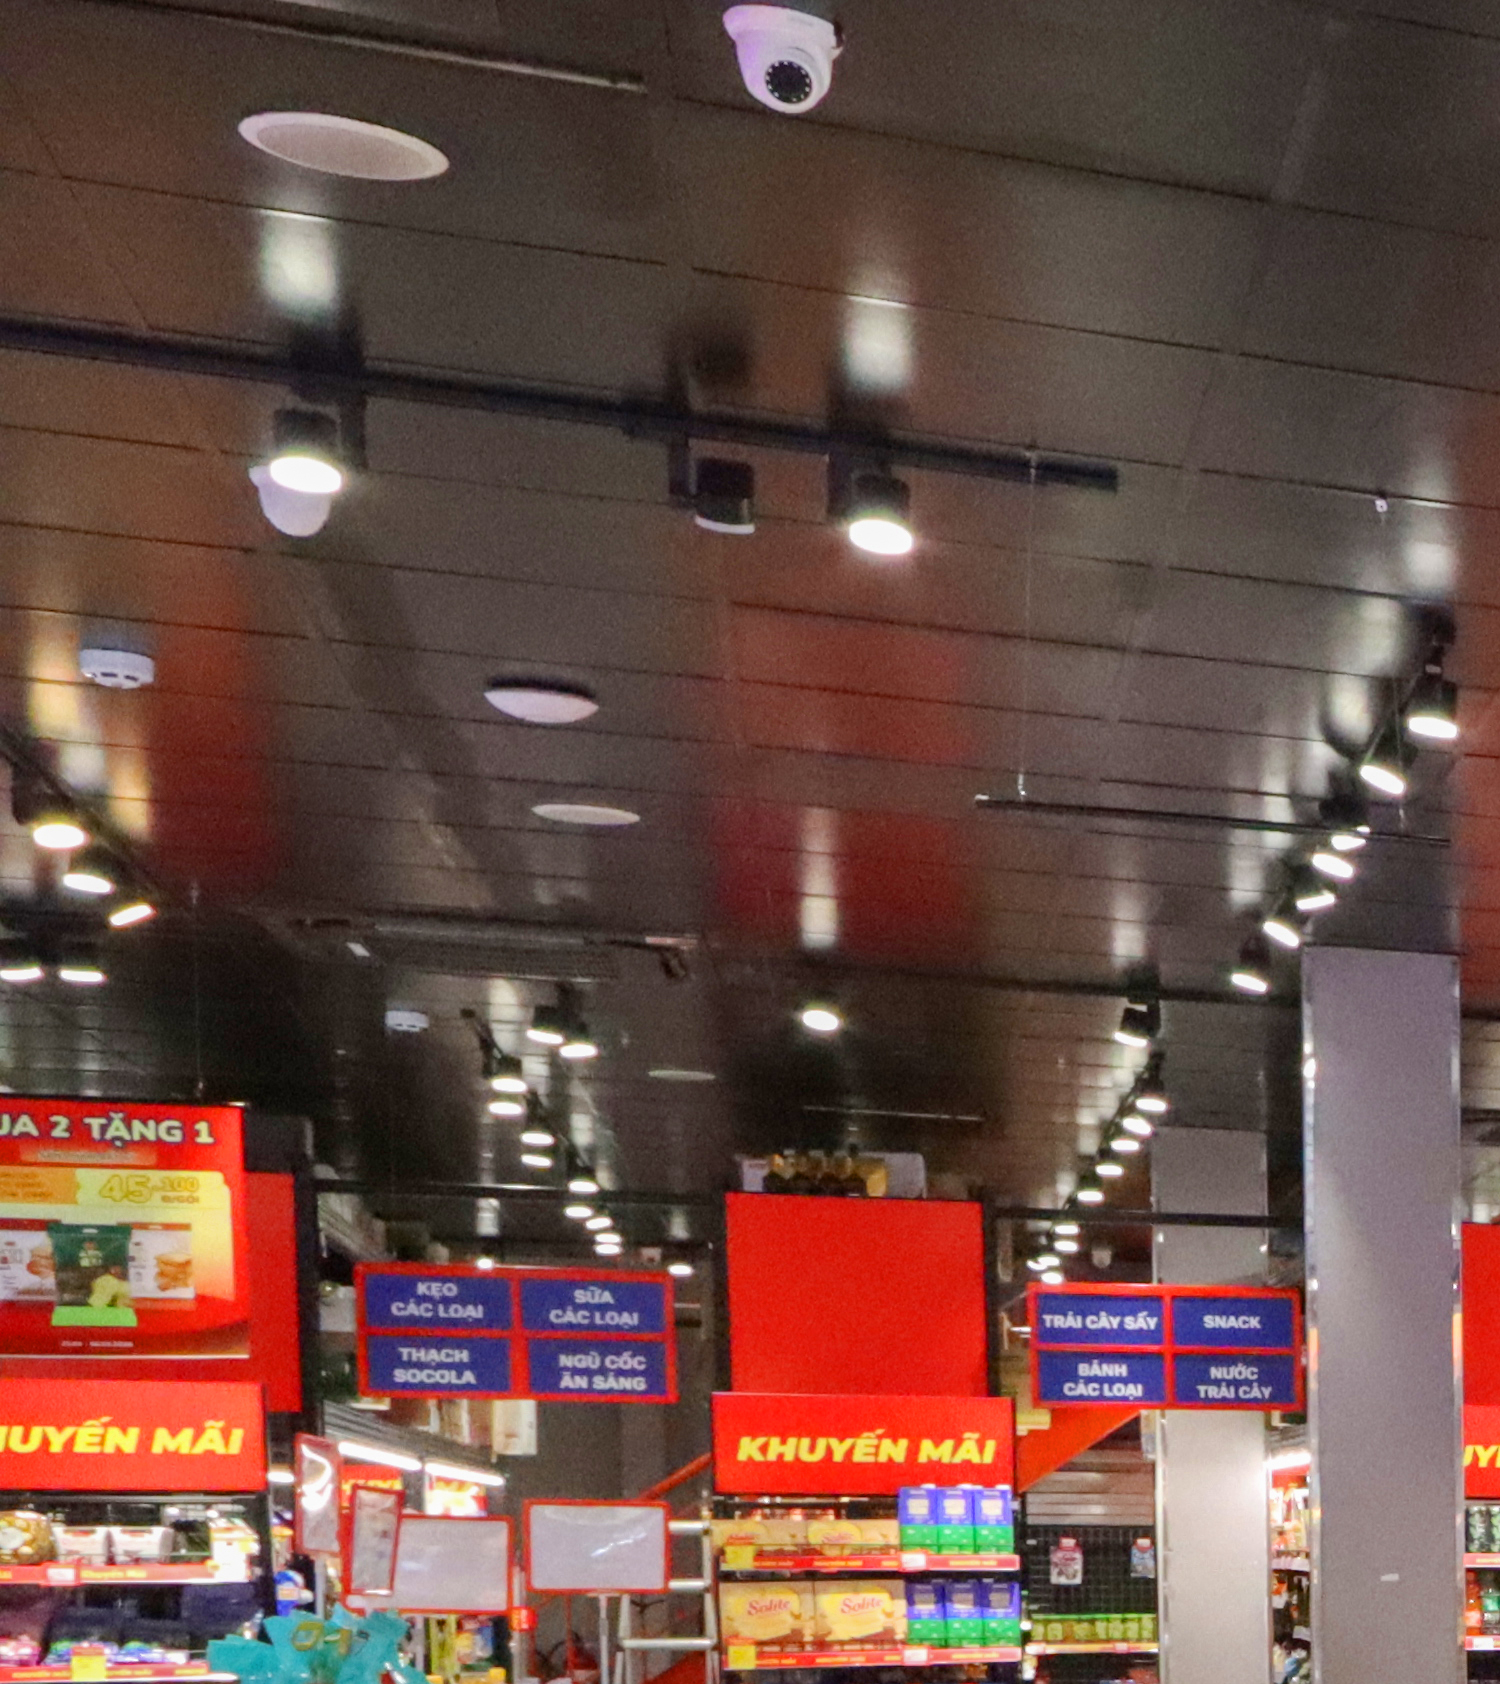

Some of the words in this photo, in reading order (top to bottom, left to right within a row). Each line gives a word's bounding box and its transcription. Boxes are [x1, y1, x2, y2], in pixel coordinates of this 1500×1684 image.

[50, 1115, 71, 1138] 2
[84, 1111, 183, 1147] TẶNG
[194, 1121, 215, 1144] 1
[391, 1301, 433, 1318] CÁC
[437, 1304, 484, 1323] LOẠI
[549, 1308, 590, 1325] CÁC
[594, 1312, 639, 1330] LOẠI
[1042, 1311, 1082, 1329] TRÁI
[1085, 1311, 1121, 1330] CÂY
[1203, 1315, 1261, 1330] SNACK
[398, 1346, 470, 1366] THẠCH
[604, 1351, 647, 1370] CỐC
[393, 1368, 476, 1385] SOCOLA
[1077, 1360, 1128, 1378] BÁNH
[1210, 1366, 1259, 1381] NƯỚC
[592, 1374, 647, 1391] SÁNG
[1063, 1380, 1100, 1397] CÁC
[1103, 1383, 1143, 1401] LOẠI
[1197, 1384, 1236, 1399] TRÁI
[1238, 1384, 1272, 1400] CÂY
[0, 1415, 138, 1455] UYẾN
[151, 1420, 244, 1455] MÃI
[737, 1427, 909, 1464] KHUYẾN
[918, 1432, 996, 1464] MÃI
[746, 1599, 790, 1617] Solite
[840, 1597, 883, 1616] Solite
